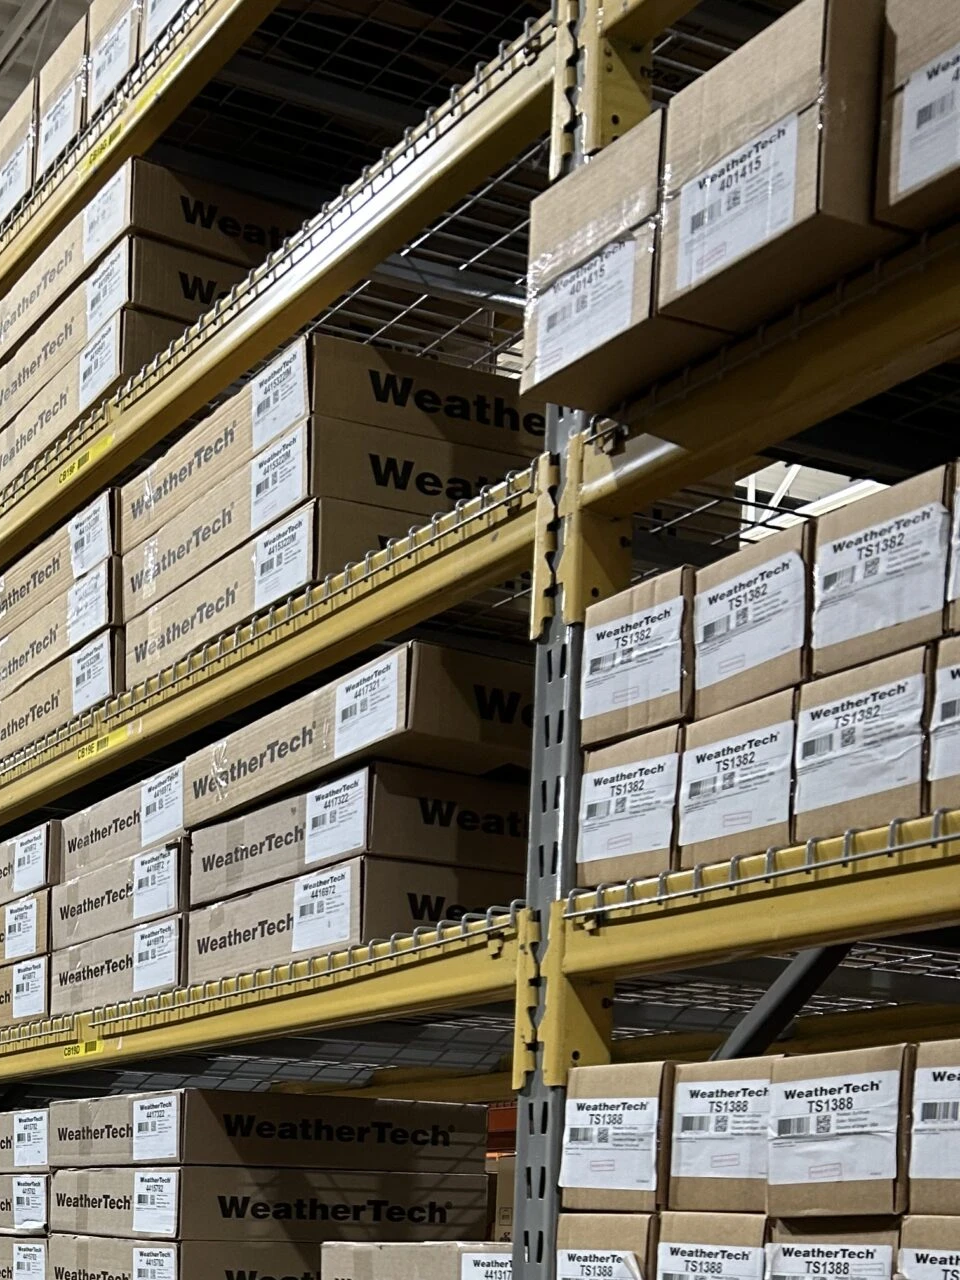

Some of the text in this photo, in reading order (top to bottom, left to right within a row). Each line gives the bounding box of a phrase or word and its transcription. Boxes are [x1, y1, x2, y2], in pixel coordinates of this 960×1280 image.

[698, 127, 786, 190] WeatherTech
[719, 156, 762, 192] 401415
[569, 264, 605, 296] 401415
[258, 354, 297, 388] WeatherTech
[258, 438, 297, 469] WeatherTech
[131, 429, 235, 520] WeatherTech
[264, 521, 303, 549] WeatherTech
[833, 508, 932, 554] WeatherTech
[131, 511, 232, 593] WeatherTech
[857, 534, 905, 560] TS1382
[708, 560, 790, 605] WeatherTech
[728, 584, 768, 609] TS1382
[134, 591, 238, 663] WeatherTech
[596, 609, 670, 641] WeatherTech
[615, 629, 651, 649] TS1382
[345, 663, 391, 694] WeatherTech
[354, 679, 380, 699] 4417321
[810, 683, 907, 721] WeatherTech
[834, 706, 880, 729] TS1382
[696, 733, 778, 764] WeatherTech
[593, 763, 664, 786] WeatherTech
[715, 752, 755, 772] TS1382
[315, 780, 359, 802] WeatherTech
[610, 780, 644, 796] TS1382
[68, 810, 140, 853] WeatherTech
[202, 830, 303, 872] WeatherTech
[303, 872, 346, 891] WeatherTech
[60, 884, 132, 921] WeatherTech
[196, 915, 293, 955] WeatherTech
[59, 958, 132, 986] WeatherTech
[784, 1081, 880, 1099] WeatherTech
[139, 1101, 172, 1111] WeatherTech
[576, 1102, 647, 1112] WeatherTech
[709, 1100, 748, 1112] TS1388
[807, 1097, 853, 1112] TS1388
[224, 1114, 449, 1147] WeatherTech
[589, 1114, 623, 1125] TS1388
[58, 1124, 133, 1142] WeatherTech
[140, 1176, 170, 1184] WeatherTech
[56, 1193, 129, 1210] WeatherTech
[218, 1196, 447, 1224] WeatherTech
[139, 1251, 170, 1259] WeatherTech
[670, 1247, 749, 1261] WeatherTech
[782, 1247, 875, 1259] WeatherTech
[580, 1265, 613, 1277] TS1388
[684, 1260, 722, 1274] TS1388
[805, 1262, 849, 1275] TS1388
